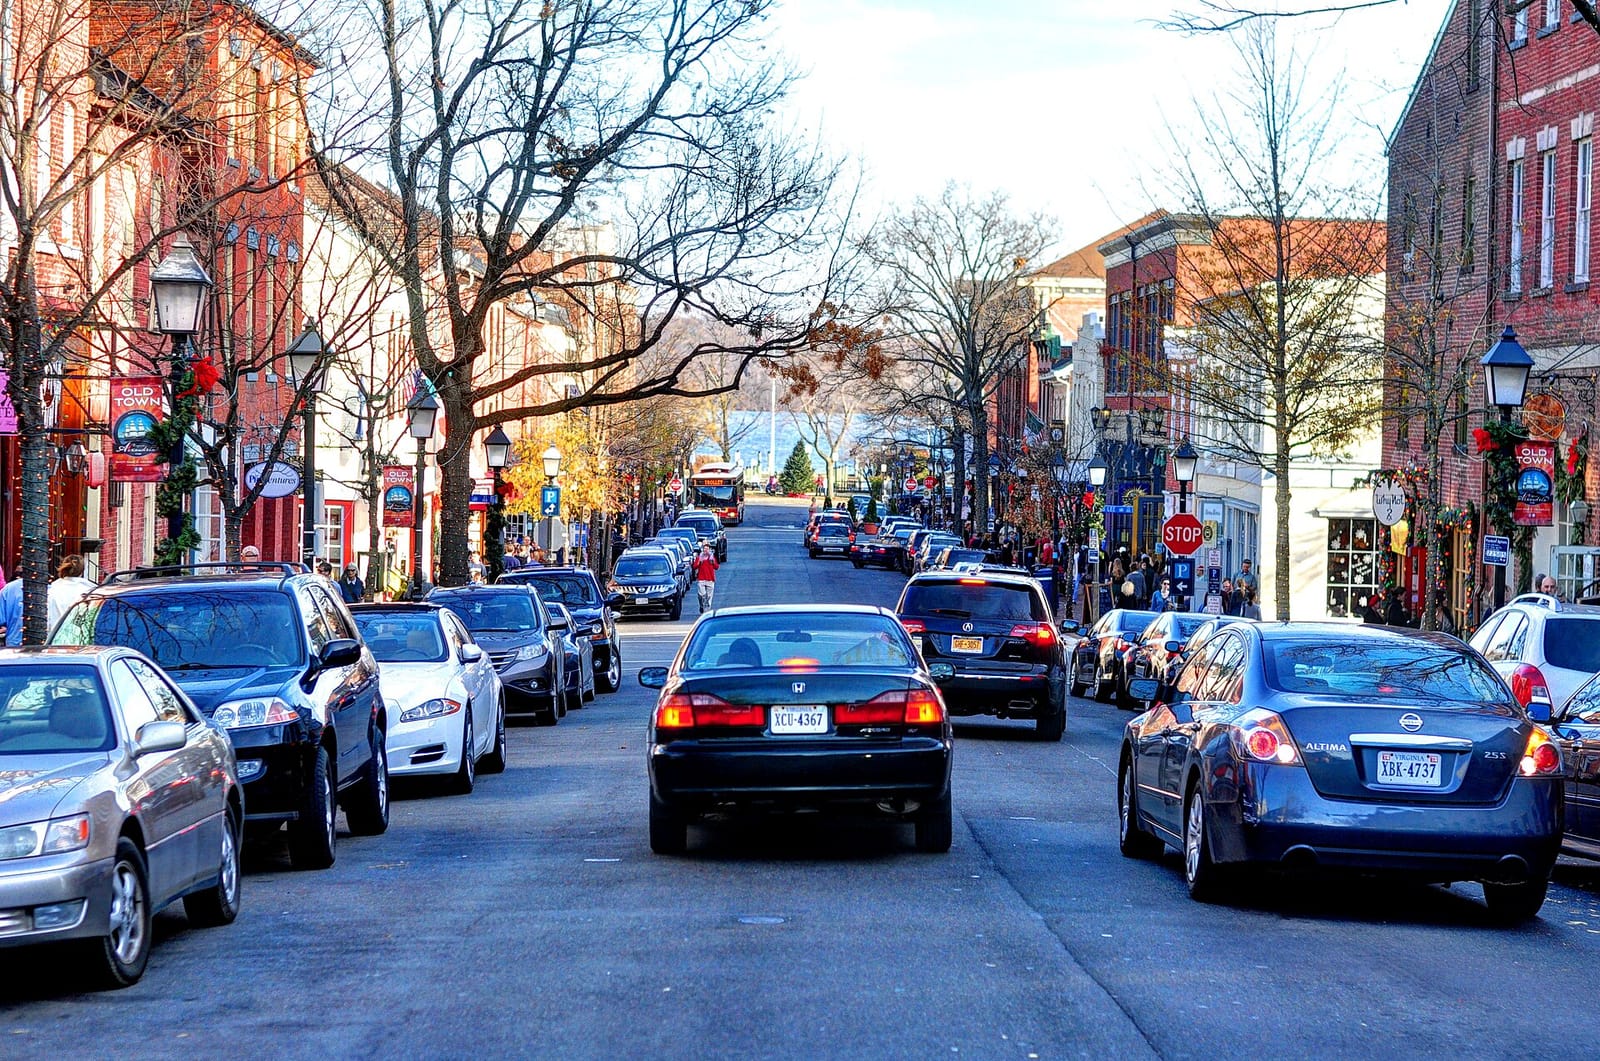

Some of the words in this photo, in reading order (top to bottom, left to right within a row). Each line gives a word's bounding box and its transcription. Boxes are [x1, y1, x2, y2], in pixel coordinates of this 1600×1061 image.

[121, 387, 154, 396] OLD
[114, 397, 161, 407] TOWN
[1521, 448, 1547, 457] OLD
[1516, 456, 1553, 465] TOWN
[547, 491, 555, 503] P
[1165, 526, 1201, 543] STOP
[1178, 564, 1188, 578] P
[775, 712, 823, 727] XCU-4367
[1305, 742, 1347, 752] ALTIMA
[1394, 753, 1426, 762] VIRGINIA
[1381, 760, 1436, 778] XBK-4737
